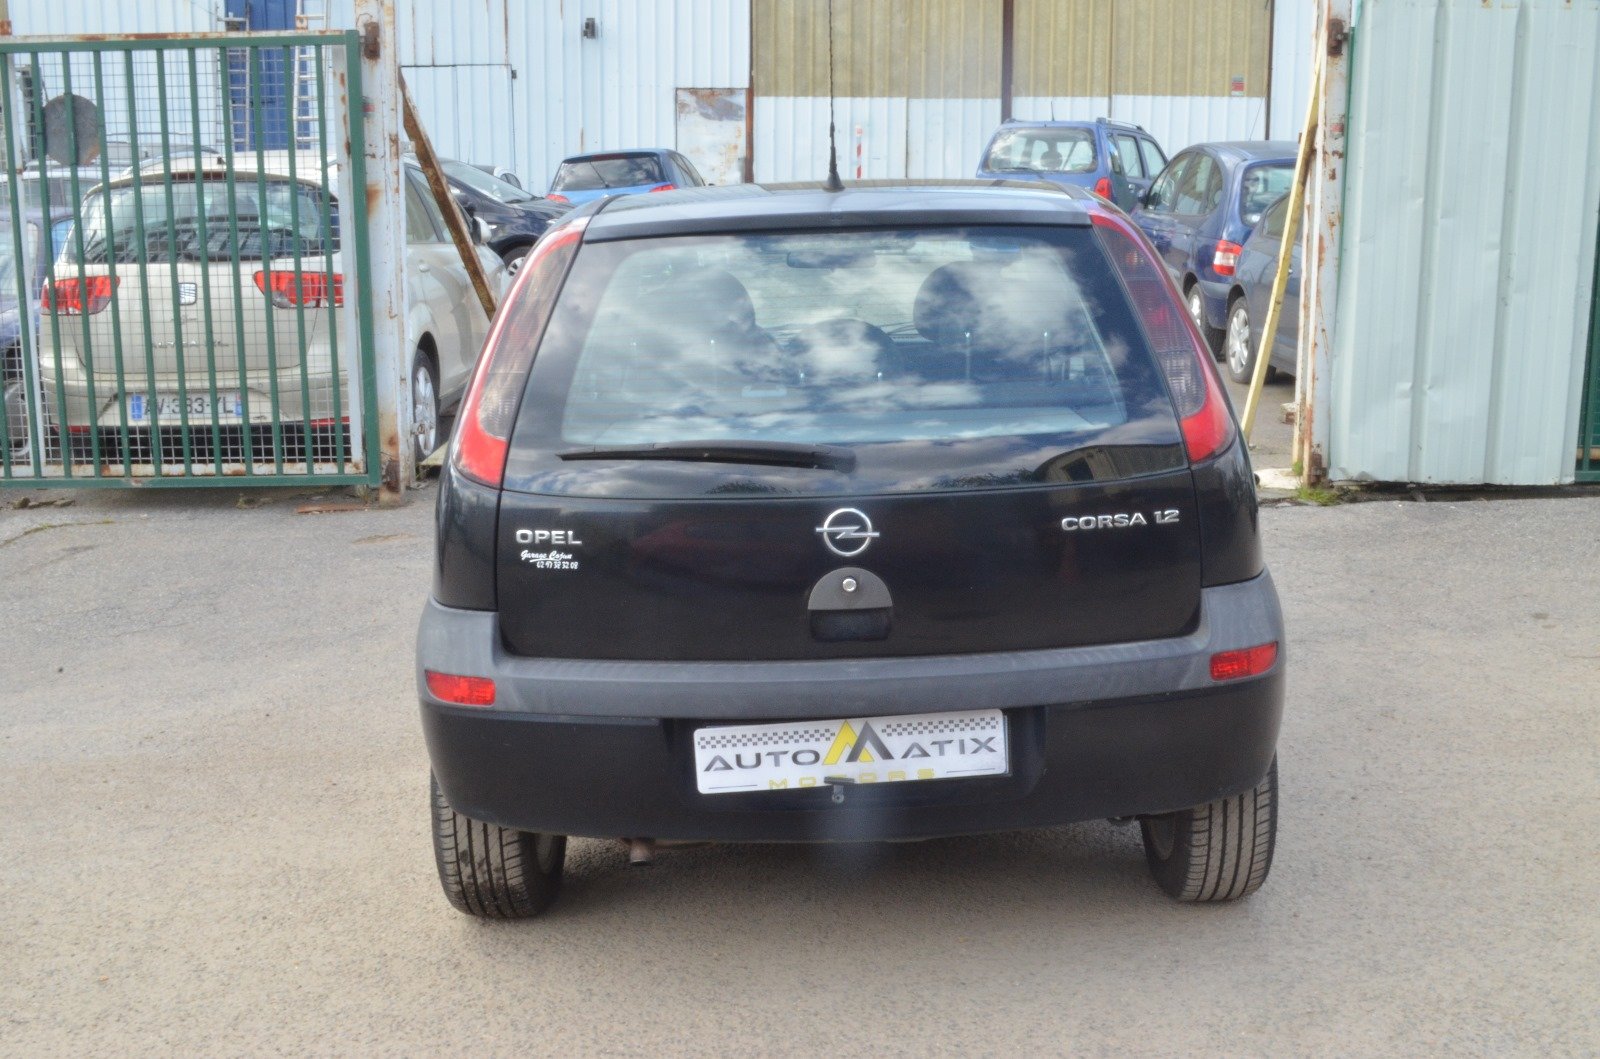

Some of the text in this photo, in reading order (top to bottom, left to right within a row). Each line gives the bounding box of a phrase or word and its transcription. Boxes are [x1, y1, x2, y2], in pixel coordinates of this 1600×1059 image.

[1061, 512, 1147, 531] CORSA
[515, 529, 583, 545] OPEL
[520, 550, 547, 560] Garage
[704, 719, 997, 772] AUTOMATIX
[768, 768, 935, 790] MOORS
